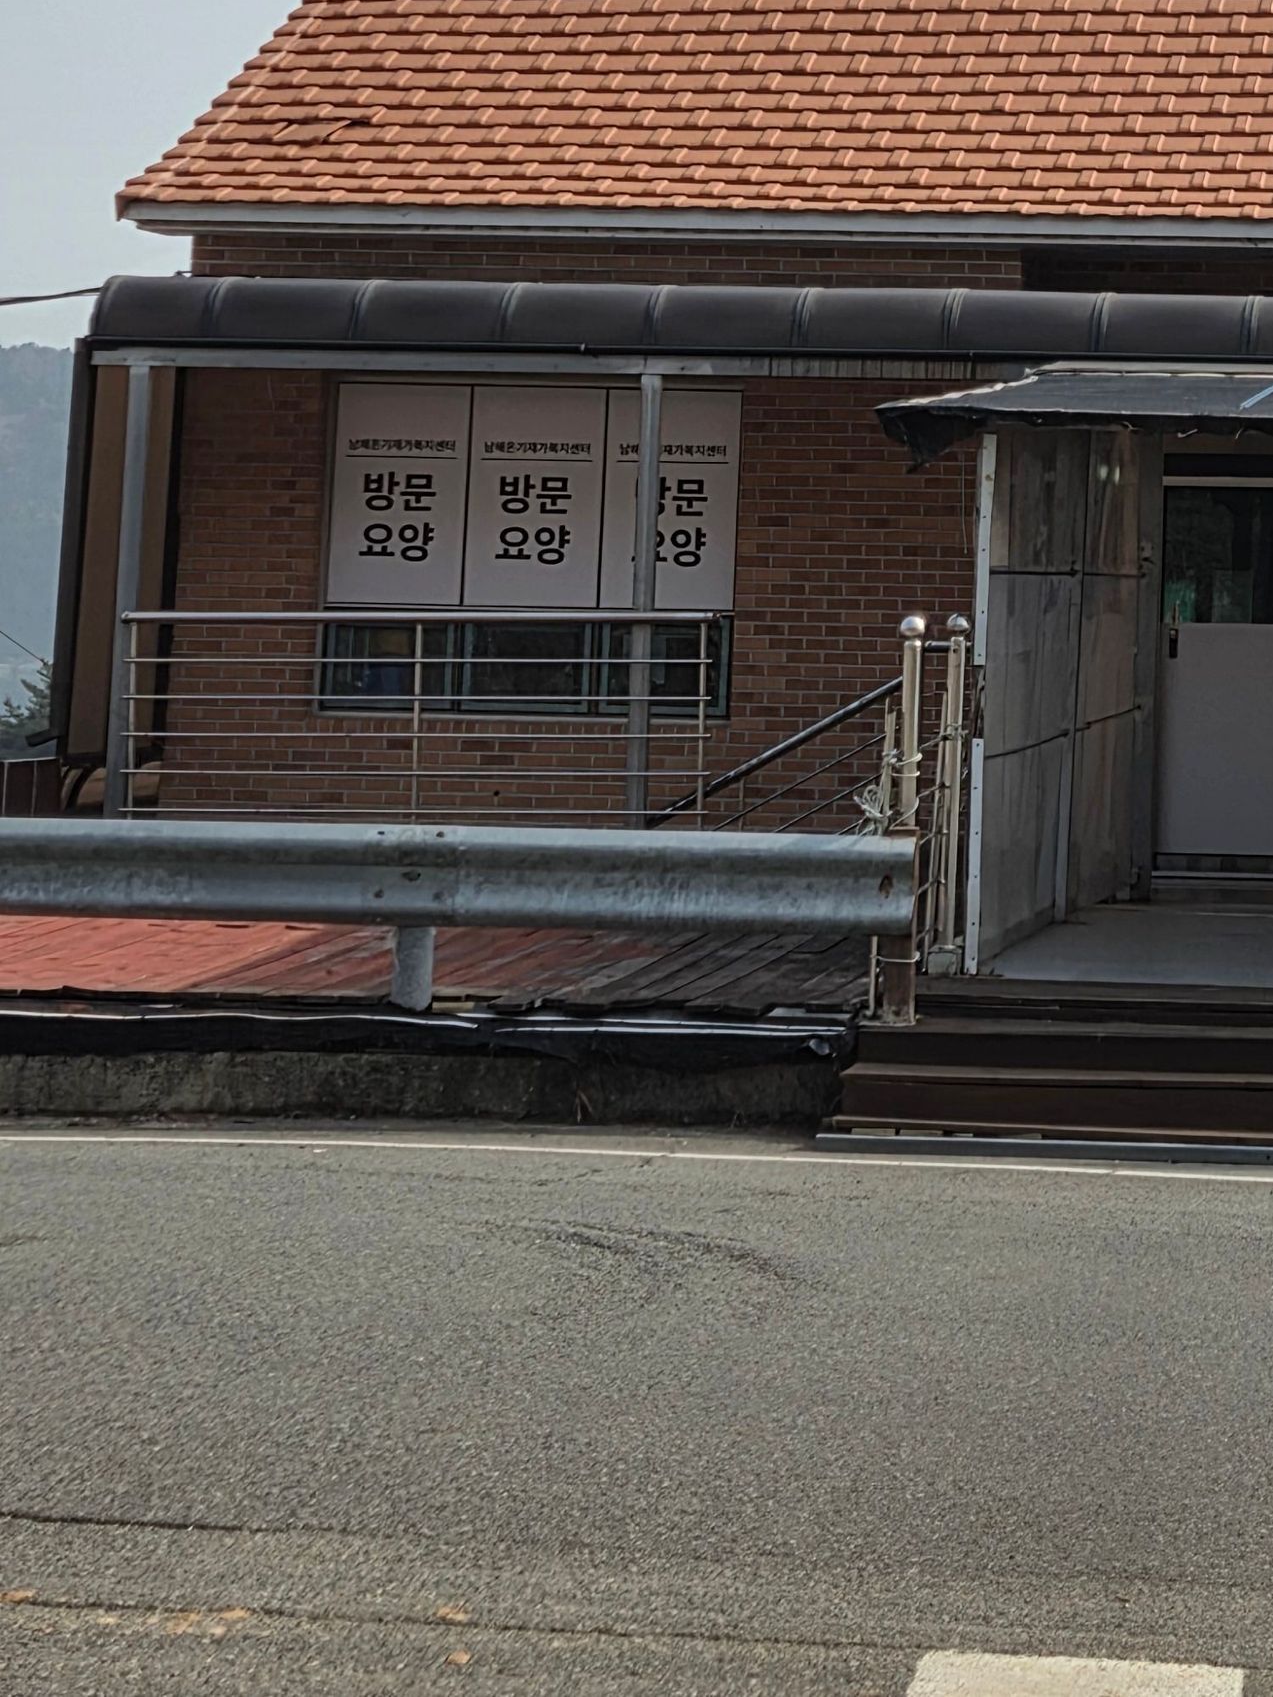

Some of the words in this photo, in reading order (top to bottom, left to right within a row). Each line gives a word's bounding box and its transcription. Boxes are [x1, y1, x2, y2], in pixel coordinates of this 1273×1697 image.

[362, 471, 437, 512] 방문
[498, 475, 572, 515] 방문
[358, 522, 436, 562] 요양
[494, 524, 572, 565] 요양
